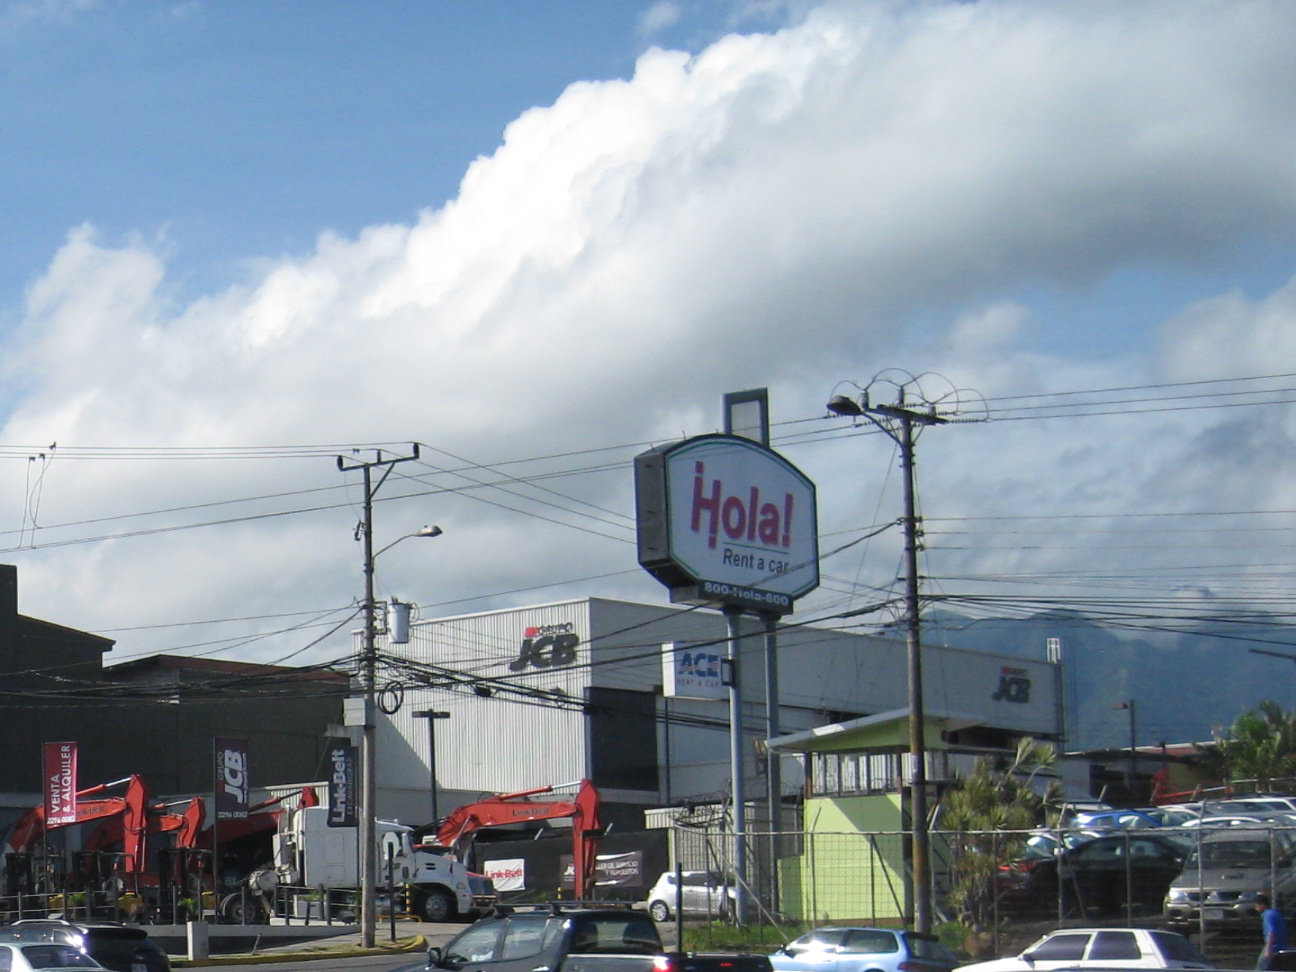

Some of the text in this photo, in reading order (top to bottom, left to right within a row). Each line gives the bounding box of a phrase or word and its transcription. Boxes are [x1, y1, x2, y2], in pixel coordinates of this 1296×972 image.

[722, 548, 790, 575] Rent a car
[509, 633, 579, 671] JCB
[677, 652, 719, 677] ACE
[61, 745, 71, 813] & ALQUILER
[216, 751, 224, 781] GRUPO
[224, 749, 244, 804] JCB
[50, 774, 61, 814] VENTA
[331, 749, 346, 823] Link-Belt
[512, 807, 549, 817] Link-Belt
[486, 868, 523, 878] Link-Belt
